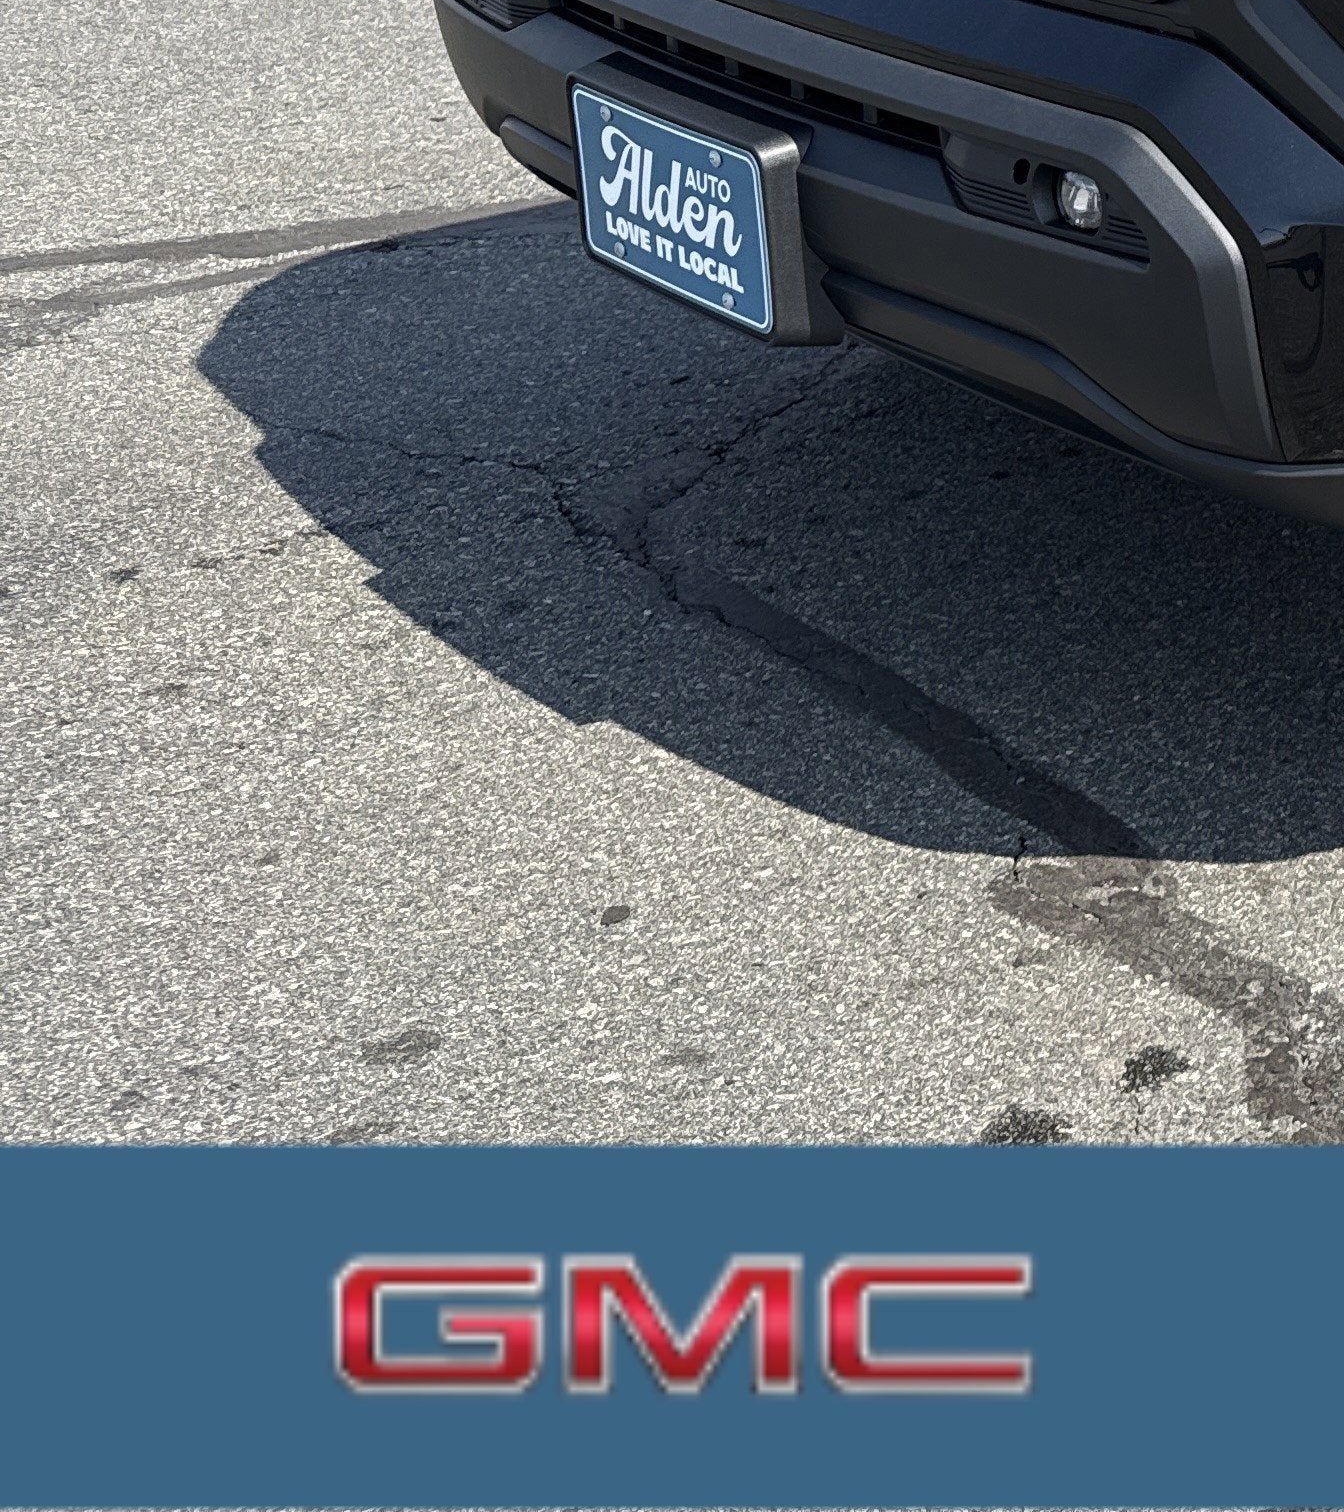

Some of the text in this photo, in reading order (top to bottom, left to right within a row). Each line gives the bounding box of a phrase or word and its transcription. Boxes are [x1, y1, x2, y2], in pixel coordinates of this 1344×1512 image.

[600, 125, 742, 257] Alden
[684, 166, 731, 203] AUTO
[605, 210, 745, 294] LOVE IT LOCAL
